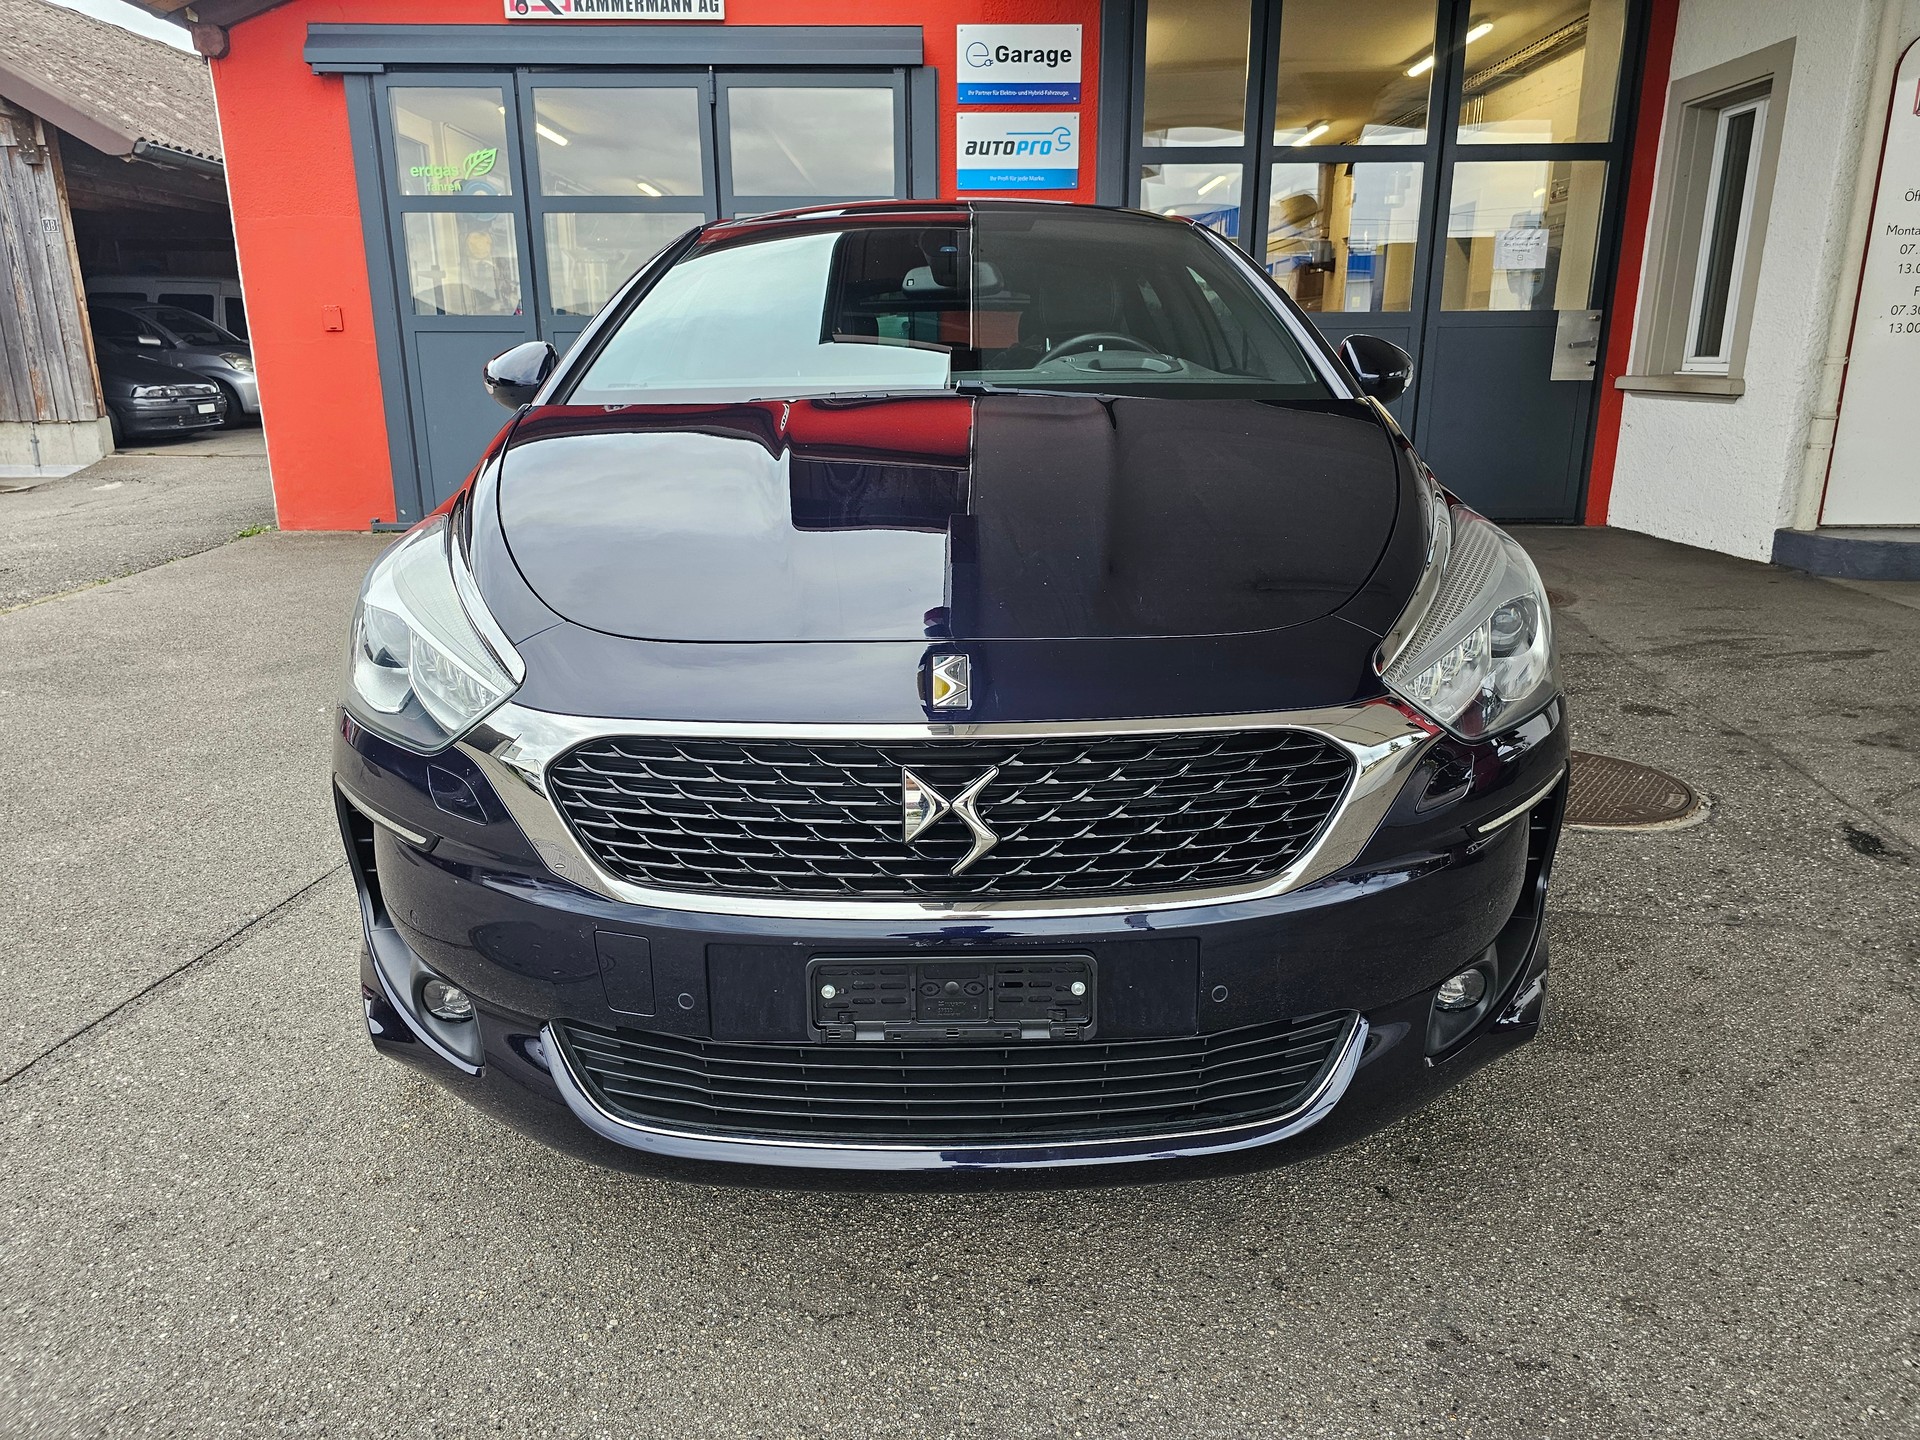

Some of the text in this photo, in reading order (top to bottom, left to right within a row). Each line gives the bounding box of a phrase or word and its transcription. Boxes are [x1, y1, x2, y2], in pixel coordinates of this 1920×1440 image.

[574, 0, 719, 12] KAMMERMANN AG
[995, 45, 1072, 68] Garage
[410, 164, 459, 179] erdgas
[427, 182, 462, 192] fahren
